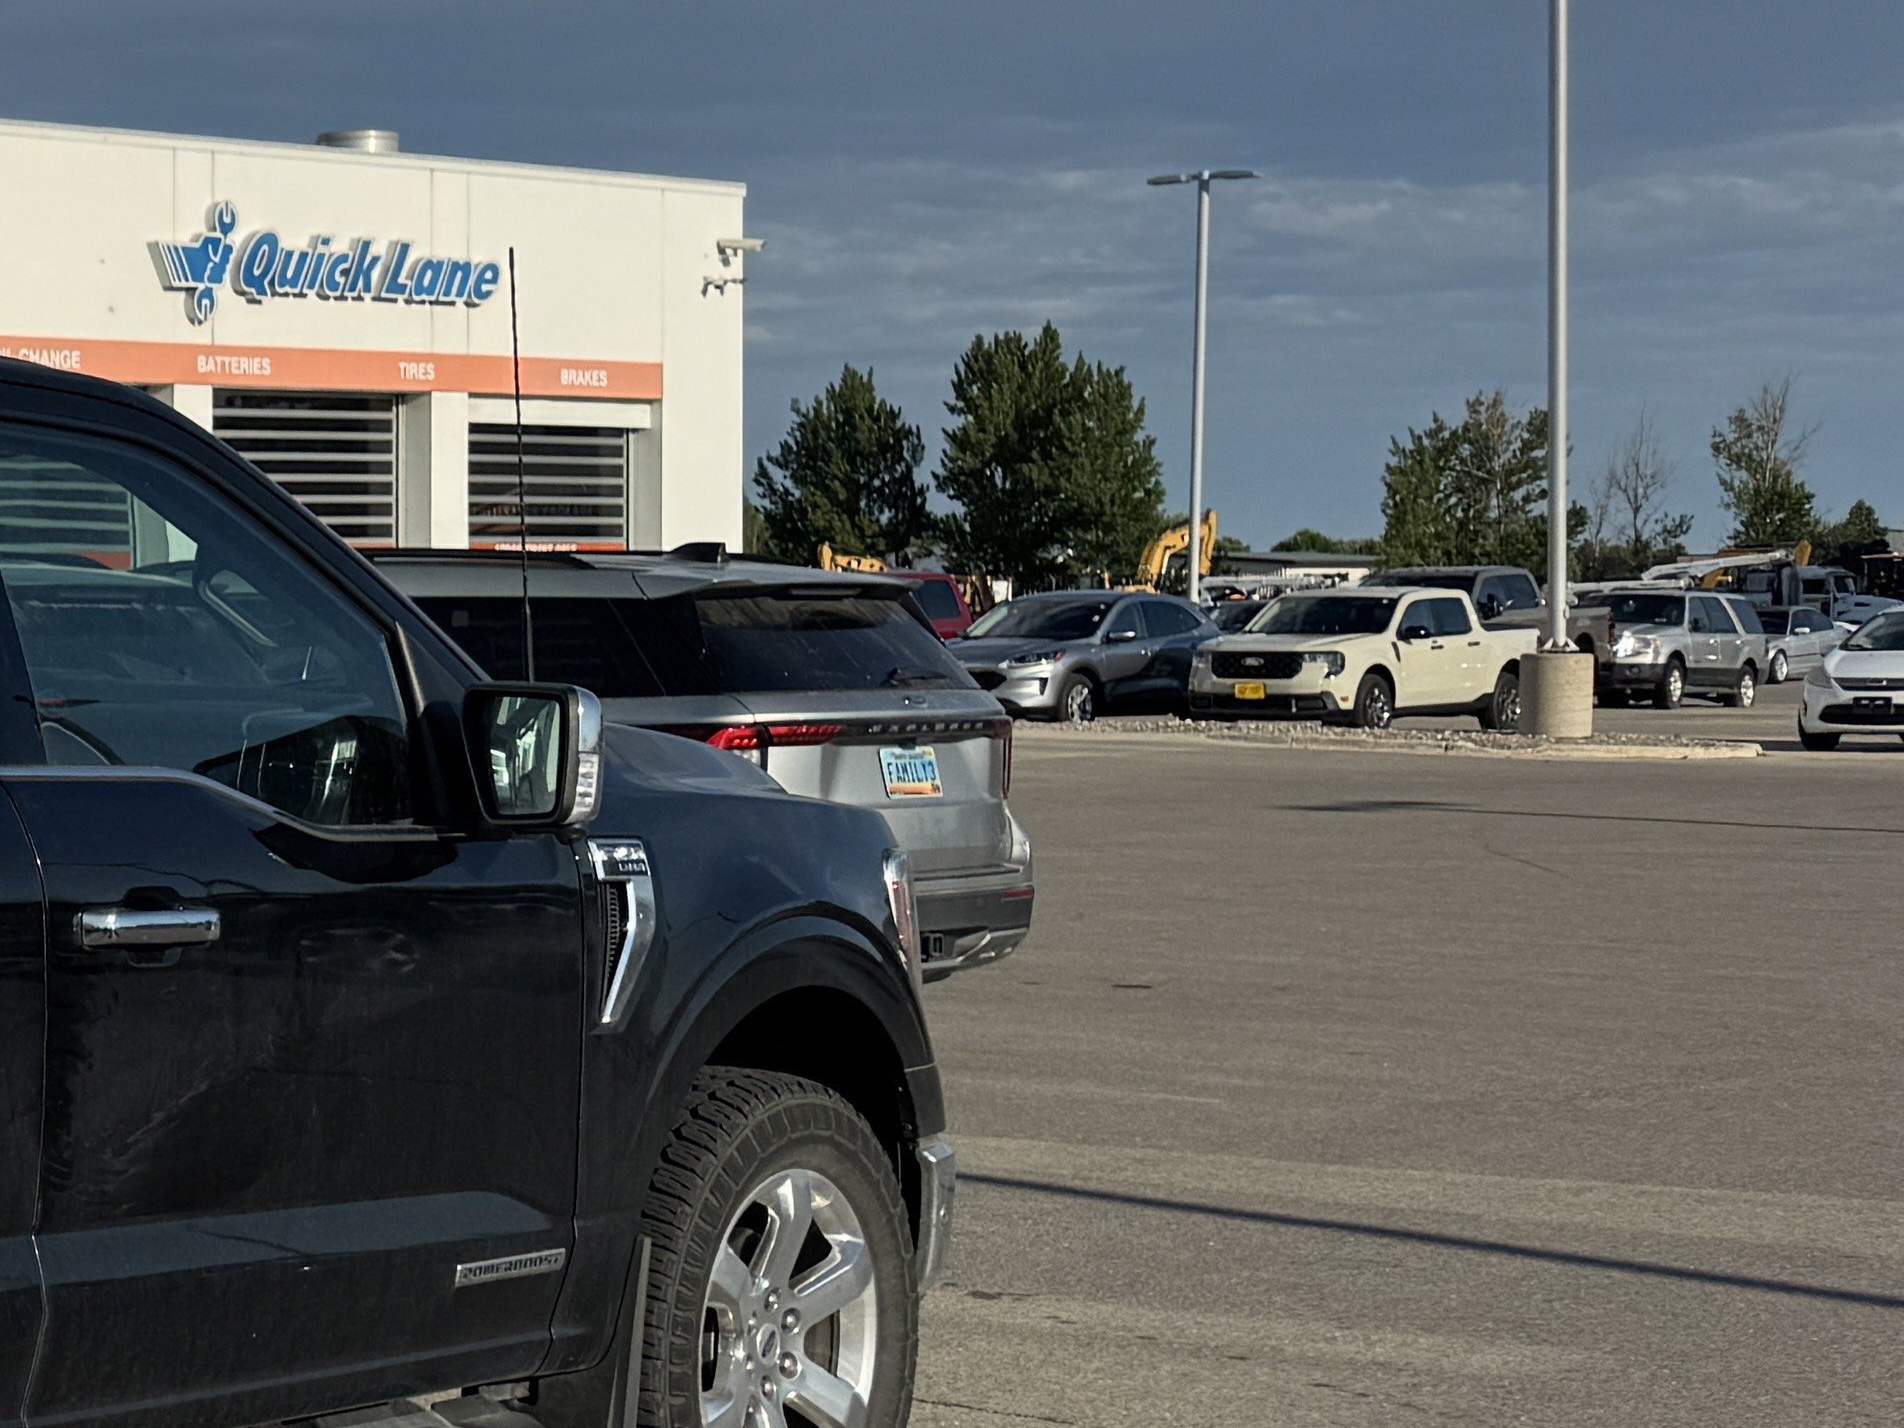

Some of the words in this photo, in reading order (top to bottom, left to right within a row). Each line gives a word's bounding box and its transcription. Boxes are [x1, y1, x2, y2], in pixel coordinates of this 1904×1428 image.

[196, 354, 272, 376] BATTERIES
[398, 361, 436, 381] TIRES
[560, 368, 608, 388] BRAKES
[887, 760, 937, 784] FAMILY3
